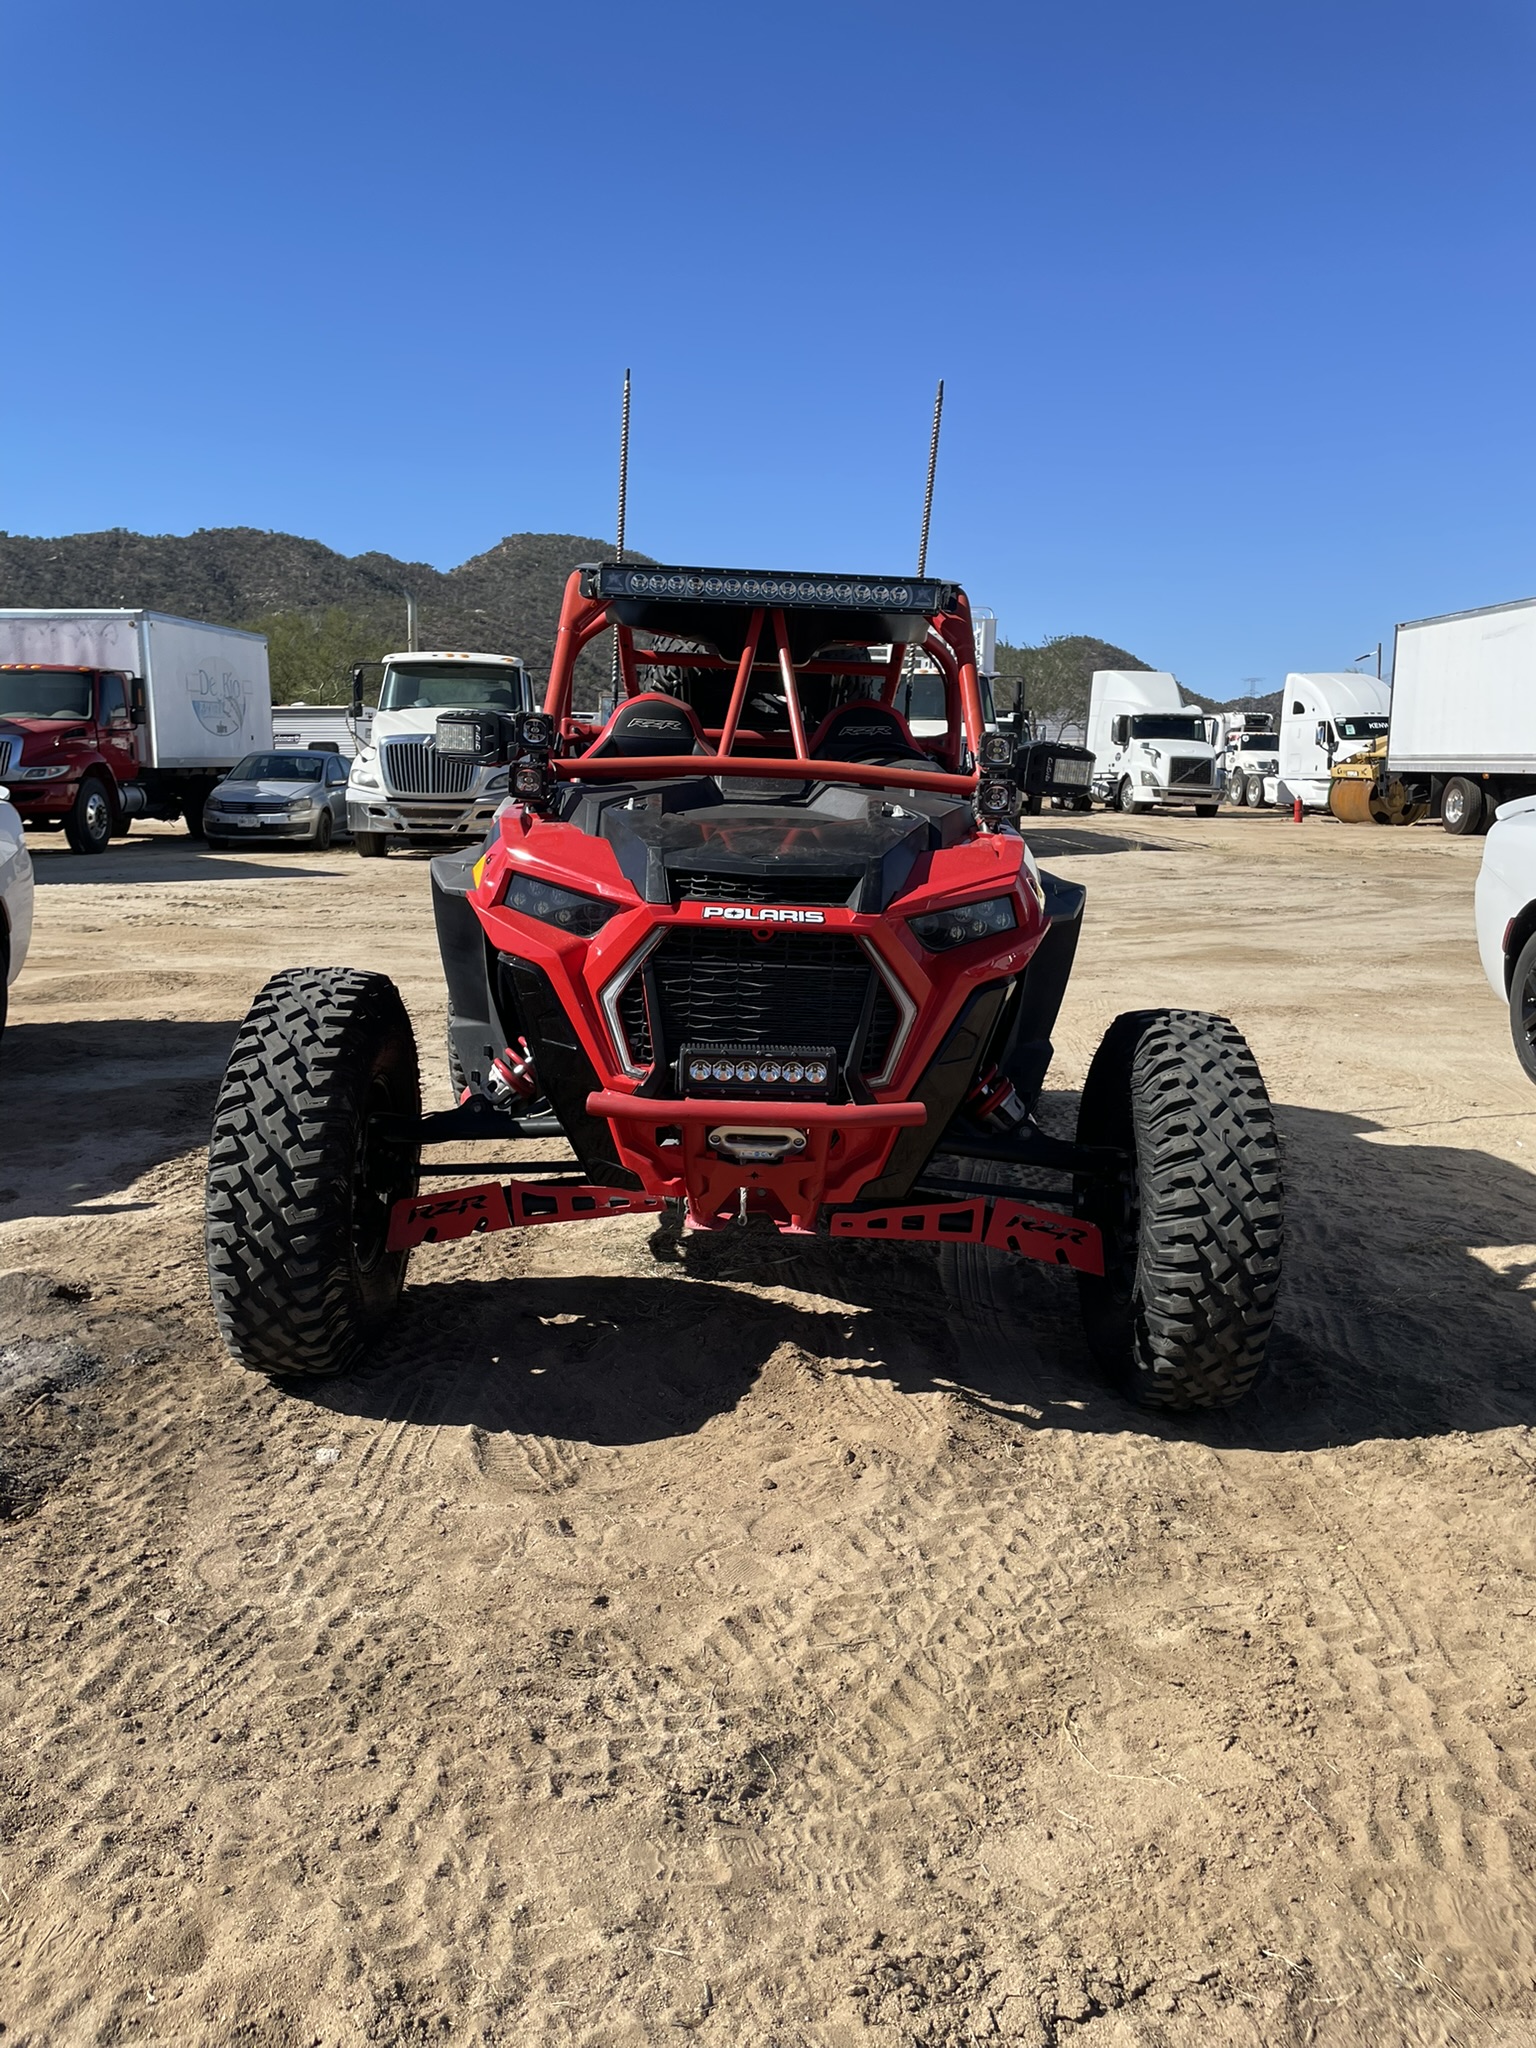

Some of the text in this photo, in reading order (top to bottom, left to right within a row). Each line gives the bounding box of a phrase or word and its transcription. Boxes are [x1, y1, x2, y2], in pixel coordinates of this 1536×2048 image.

[627, 717, 682, 730] RZR
[838, 725, 893, 737] RZR
[703, 906, 826, 924] POLARIS
[407, 1194, 488, 1225] RZR
[1005, 1214, 1089, 1246] RZR
